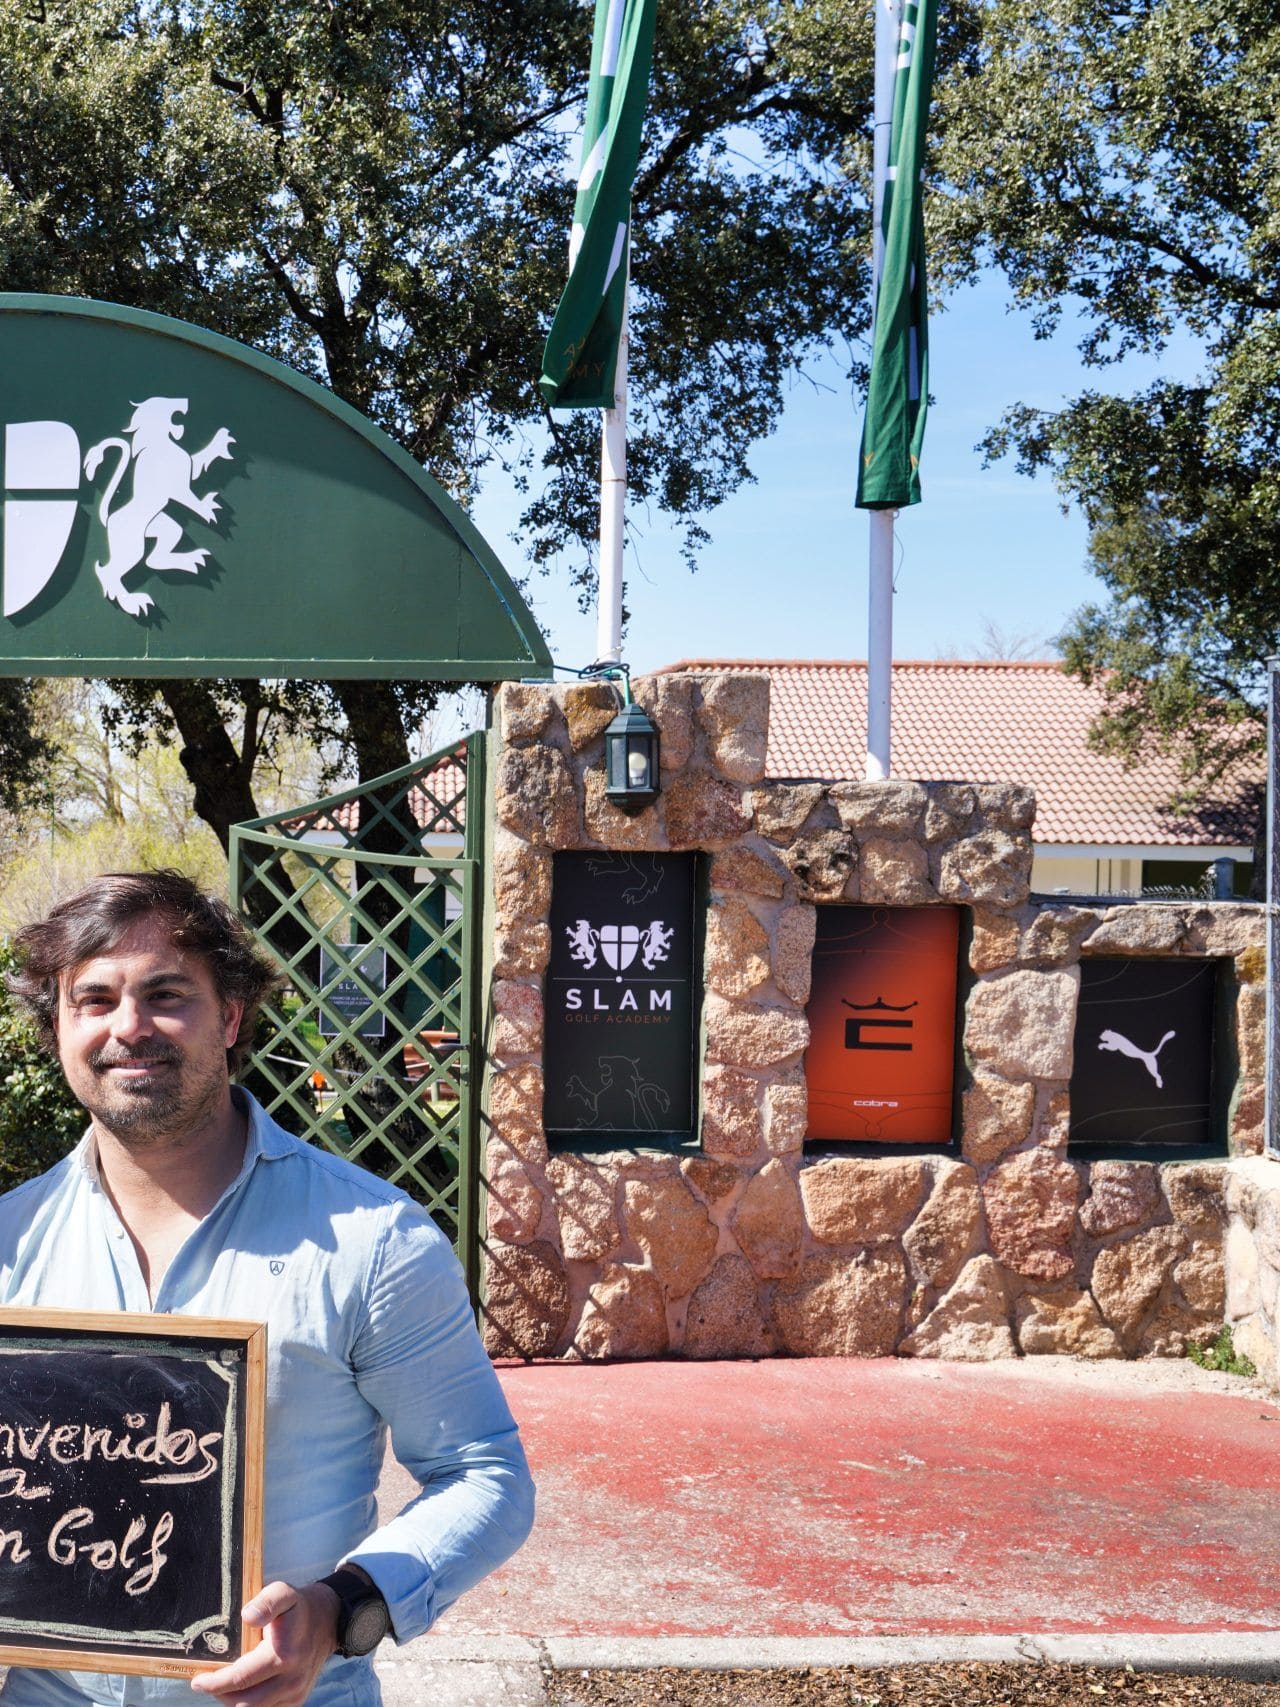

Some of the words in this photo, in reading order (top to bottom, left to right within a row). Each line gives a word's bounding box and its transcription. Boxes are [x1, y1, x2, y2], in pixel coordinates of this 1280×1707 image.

[565, 988, 672, 1011] SLAM
[565, 1014, 600, 1023] GOLF
[606, 1014, 671, 1024] ACADEMY
[47, 1506, 175, 1597] Golf
